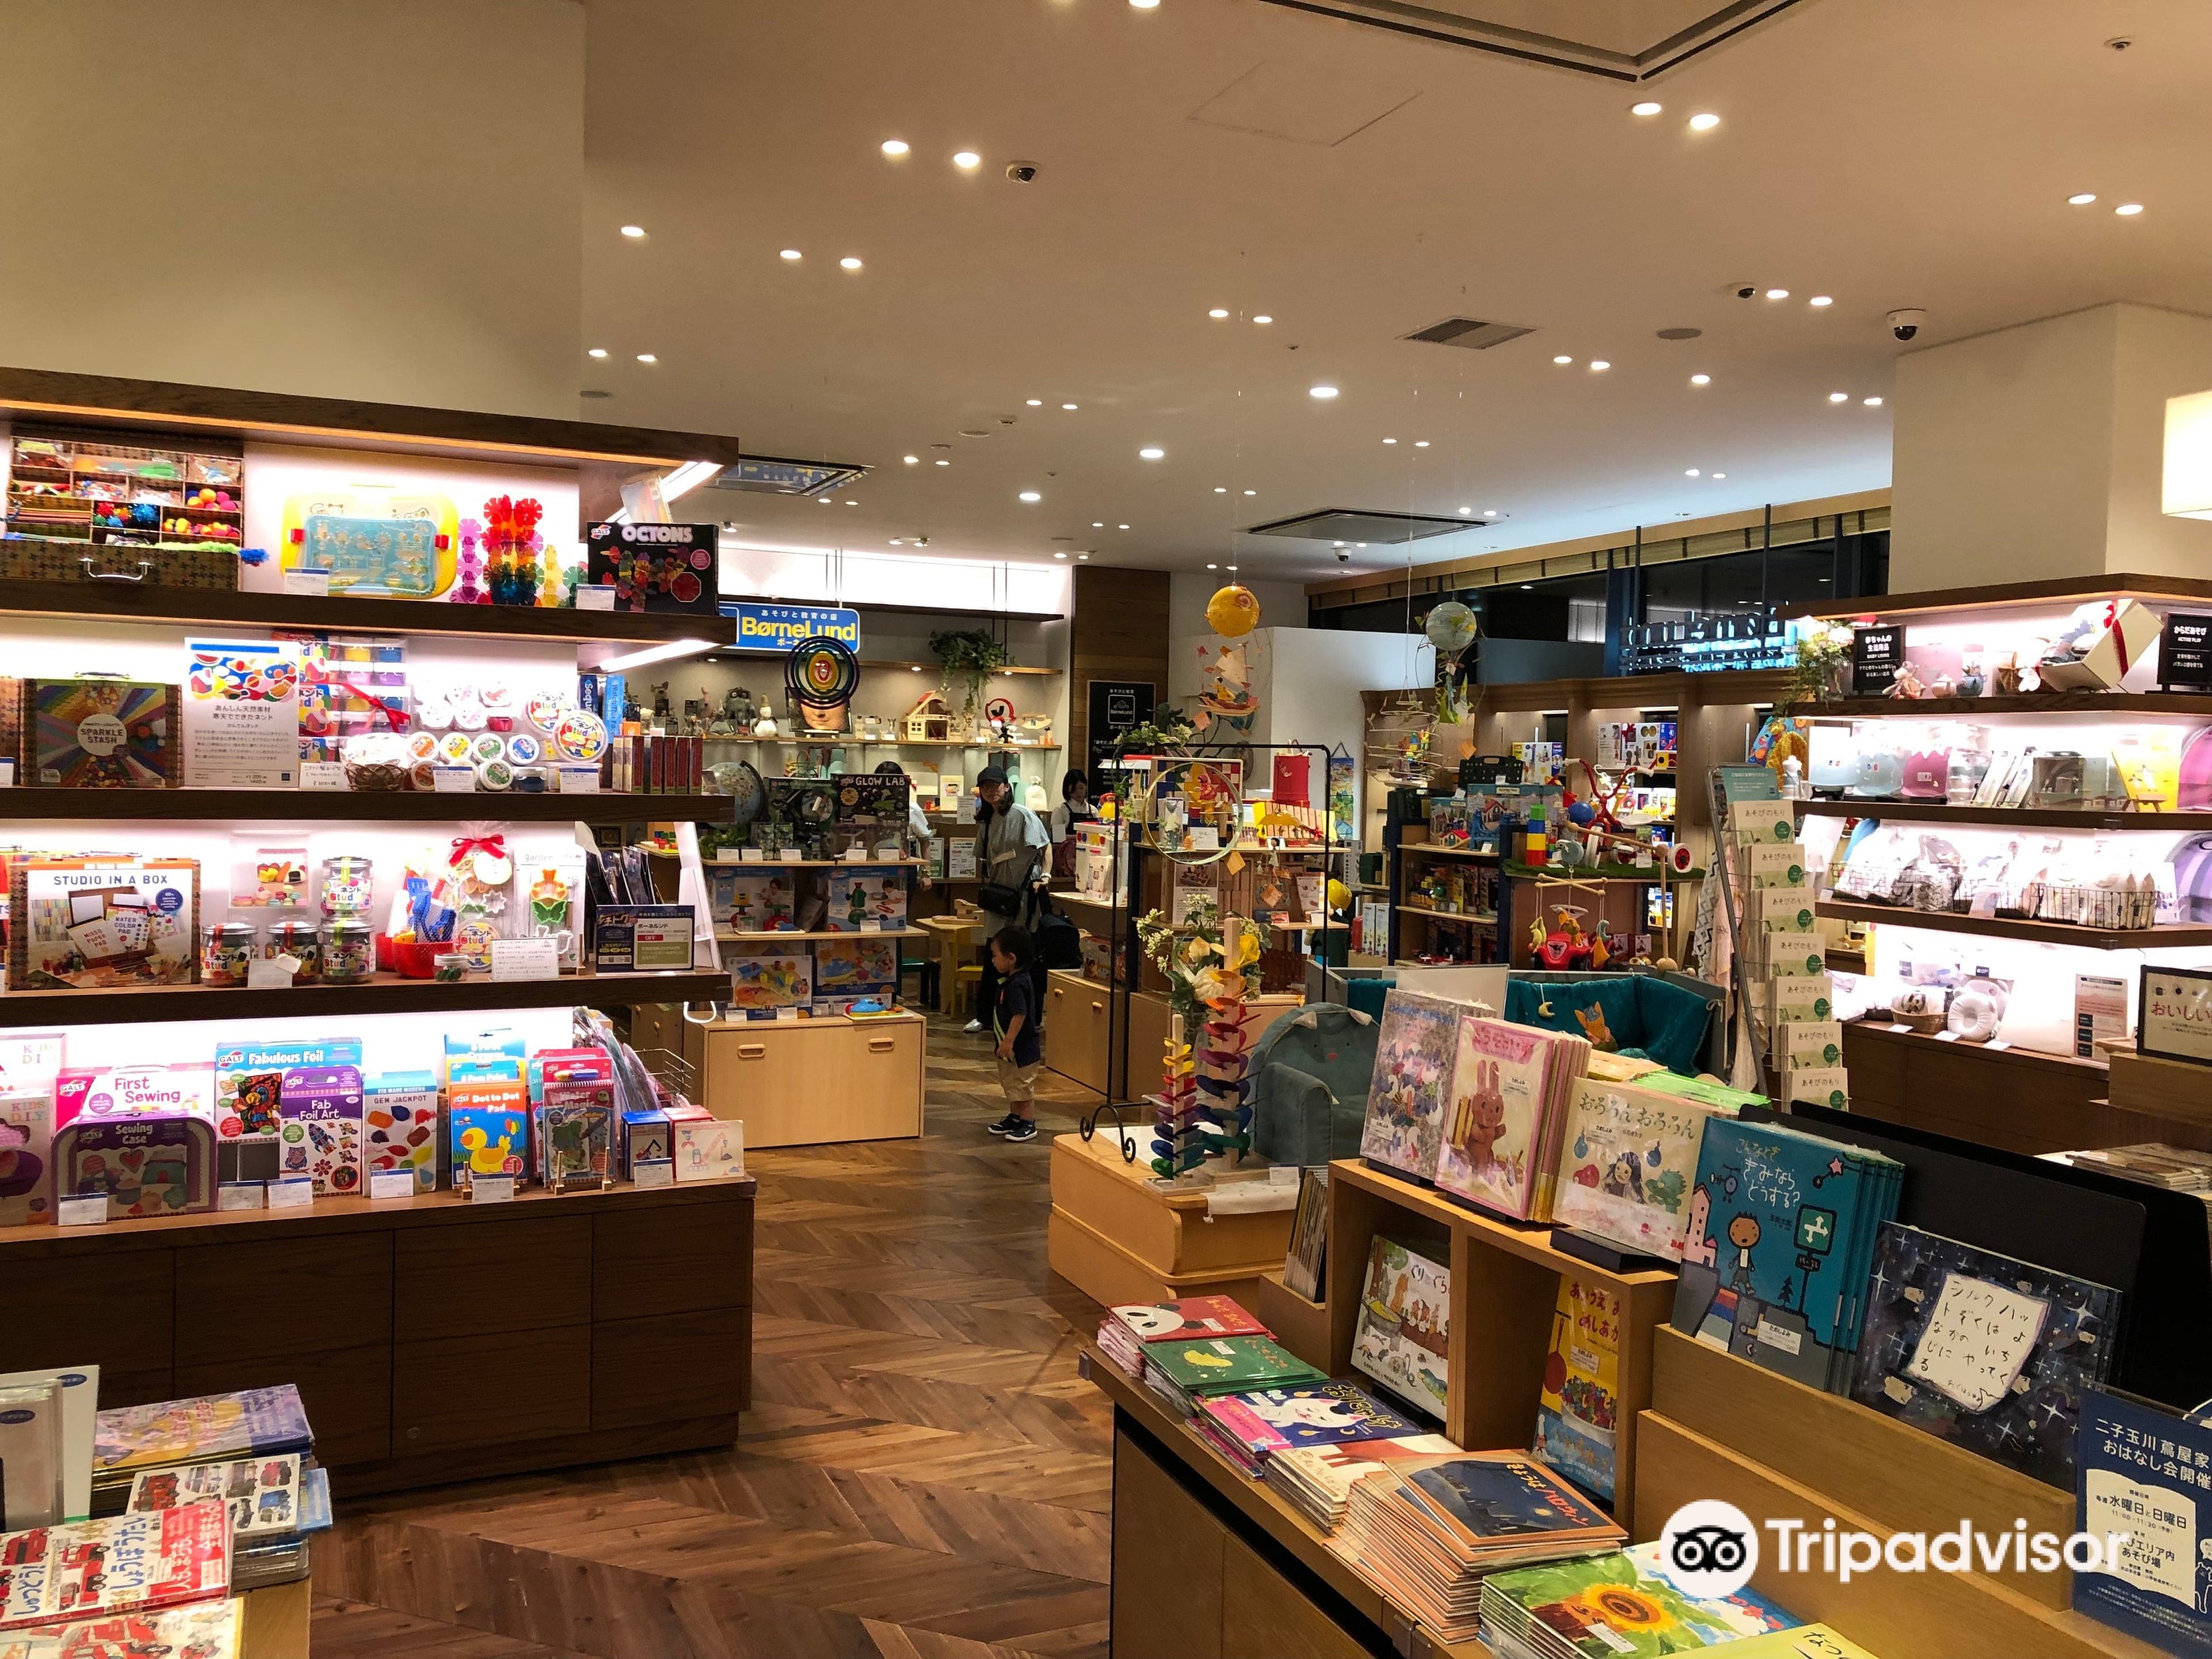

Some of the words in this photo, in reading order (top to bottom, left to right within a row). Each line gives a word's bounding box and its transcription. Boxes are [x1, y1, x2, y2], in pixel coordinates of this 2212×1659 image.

[622, 525, 694, 543] OCTONS
[761, 609, 838, 621] あそびと教育の店
[741, 617, 856, 641] BørneLund
[2173, 626, 2207, 636] からだあそび
[1865, 635, 1892, 644] 赤ちゃんの
[1867, 643, 1889, 652] 生活用品
[583, 683, 593, 712] Seque
[215, 705, 271, 713] あんしん天然素材
[80, 728, 124, 736] SPARKLE
[855, 777, 881, 786] GLOW
[885, 777, 905, 786] LAB
[54, 875, 102, 885] STUDIO
[109, 874, 122, 885] IN
[128, 874, 136, 884] A
[142, 874, 168, 884] BOX
[84, 928, 103, 938] MIXED
[86, 933, 107, 944] PAPER
[248, 1051, 301, 1066] Fabulous
[303, 1049, 324, 1063] Foil
[60, 1084, 83, 1092] GALT
[115, 1076, 150, 1090] First
[124, 1090, 181, 1104] Sewing
[393, 1094, 427, 1103] JACKPOT
[472, 1094, 491, 1103] Dot
[502, 1092, 520, 1100] Dot
[11, 1100, 46, 1111] KIDS
[311, 1099, 331, 1109] Fab
[487, 1104, 506, 1112] Pad
[300, 1110, 319, 1120] Foil
[321, 1109, 339, 1119] Art
[1580, 1092, 1631, 1123] おろろん
[1637, 1107, 1695, 1139] おろろん
[115, 1123, 153, 1135] Sewing
[122, 1134, 147, 1145] Case
[1736, 1138, 1781, 1162] こんなとき
[1743, 1157, 1795, 1191] きみなら
[1769, 1324, 1791, 1338] ためしよみ
[1921, 1358, 1929, 1372] る
[2103, 1439, 2212, 1490] おはなし会開催
[2107, 1530, 2176, 1562] びエリア内
[109, 1514, 148, 1590] しょうぼうたい
[2122, 1547, 2161, 1569] あそび場
